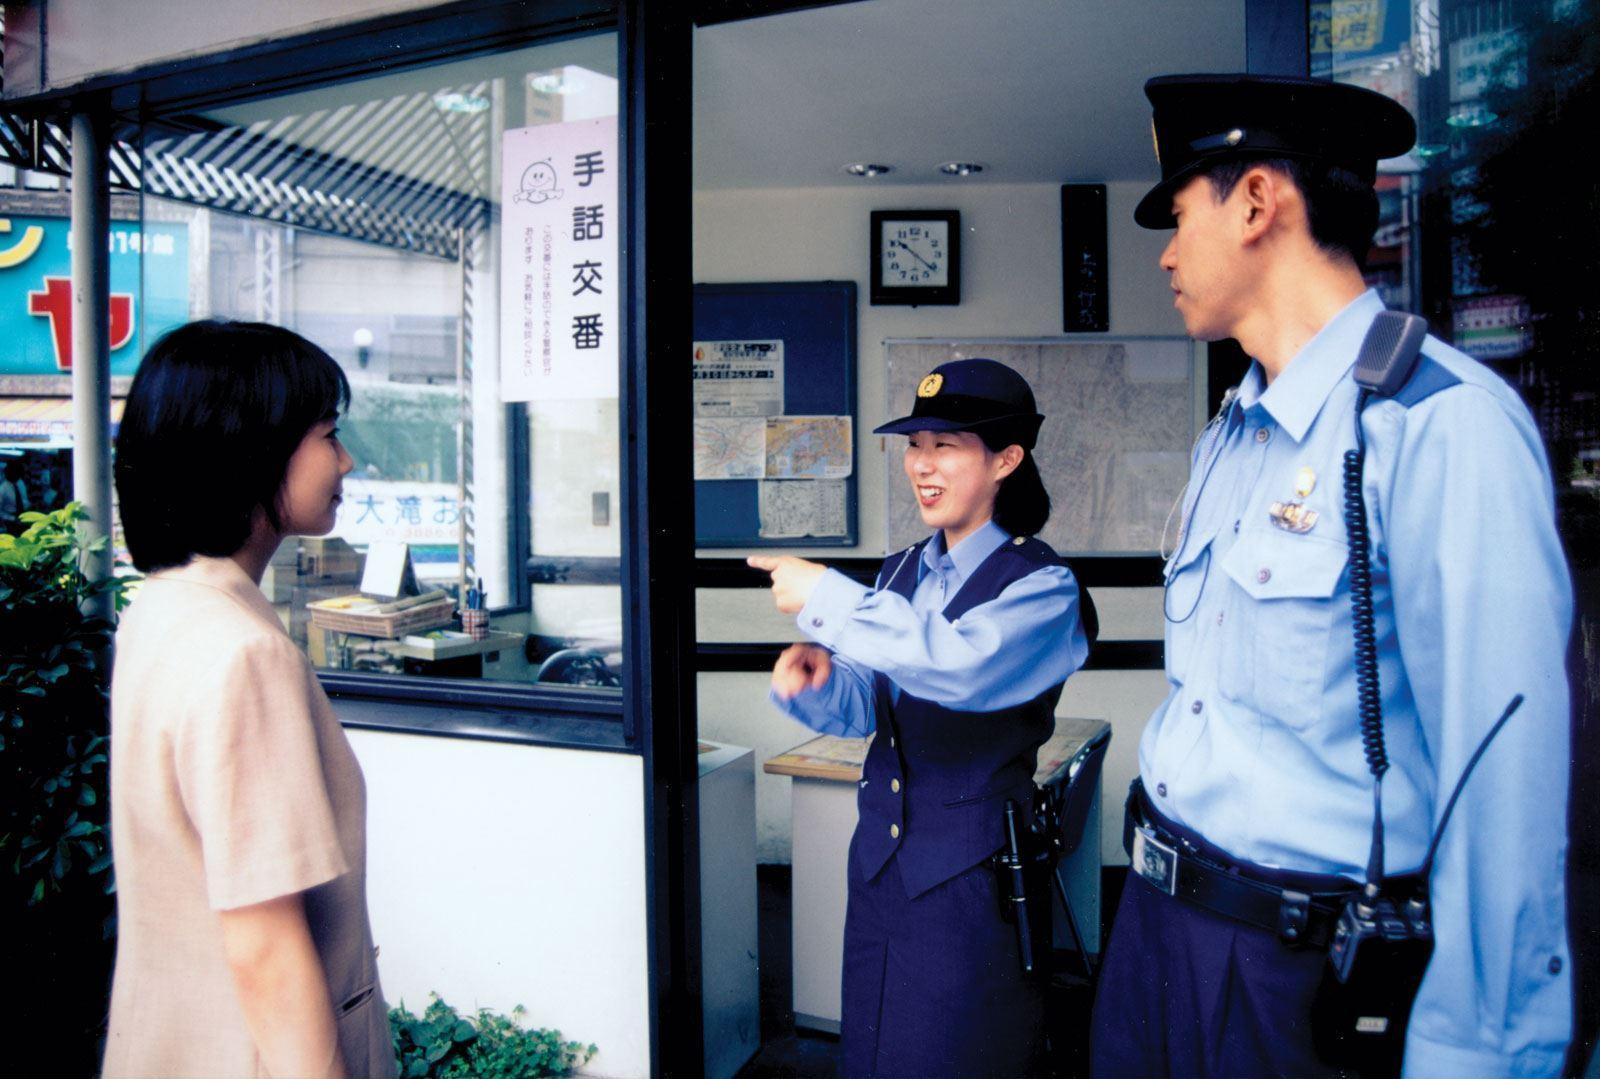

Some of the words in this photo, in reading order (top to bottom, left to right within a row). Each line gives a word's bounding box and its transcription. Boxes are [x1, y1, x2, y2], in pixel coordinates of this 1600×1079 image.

[572, 150, 605, 350] 手話交番
[891, 262, 899, 270] 8
